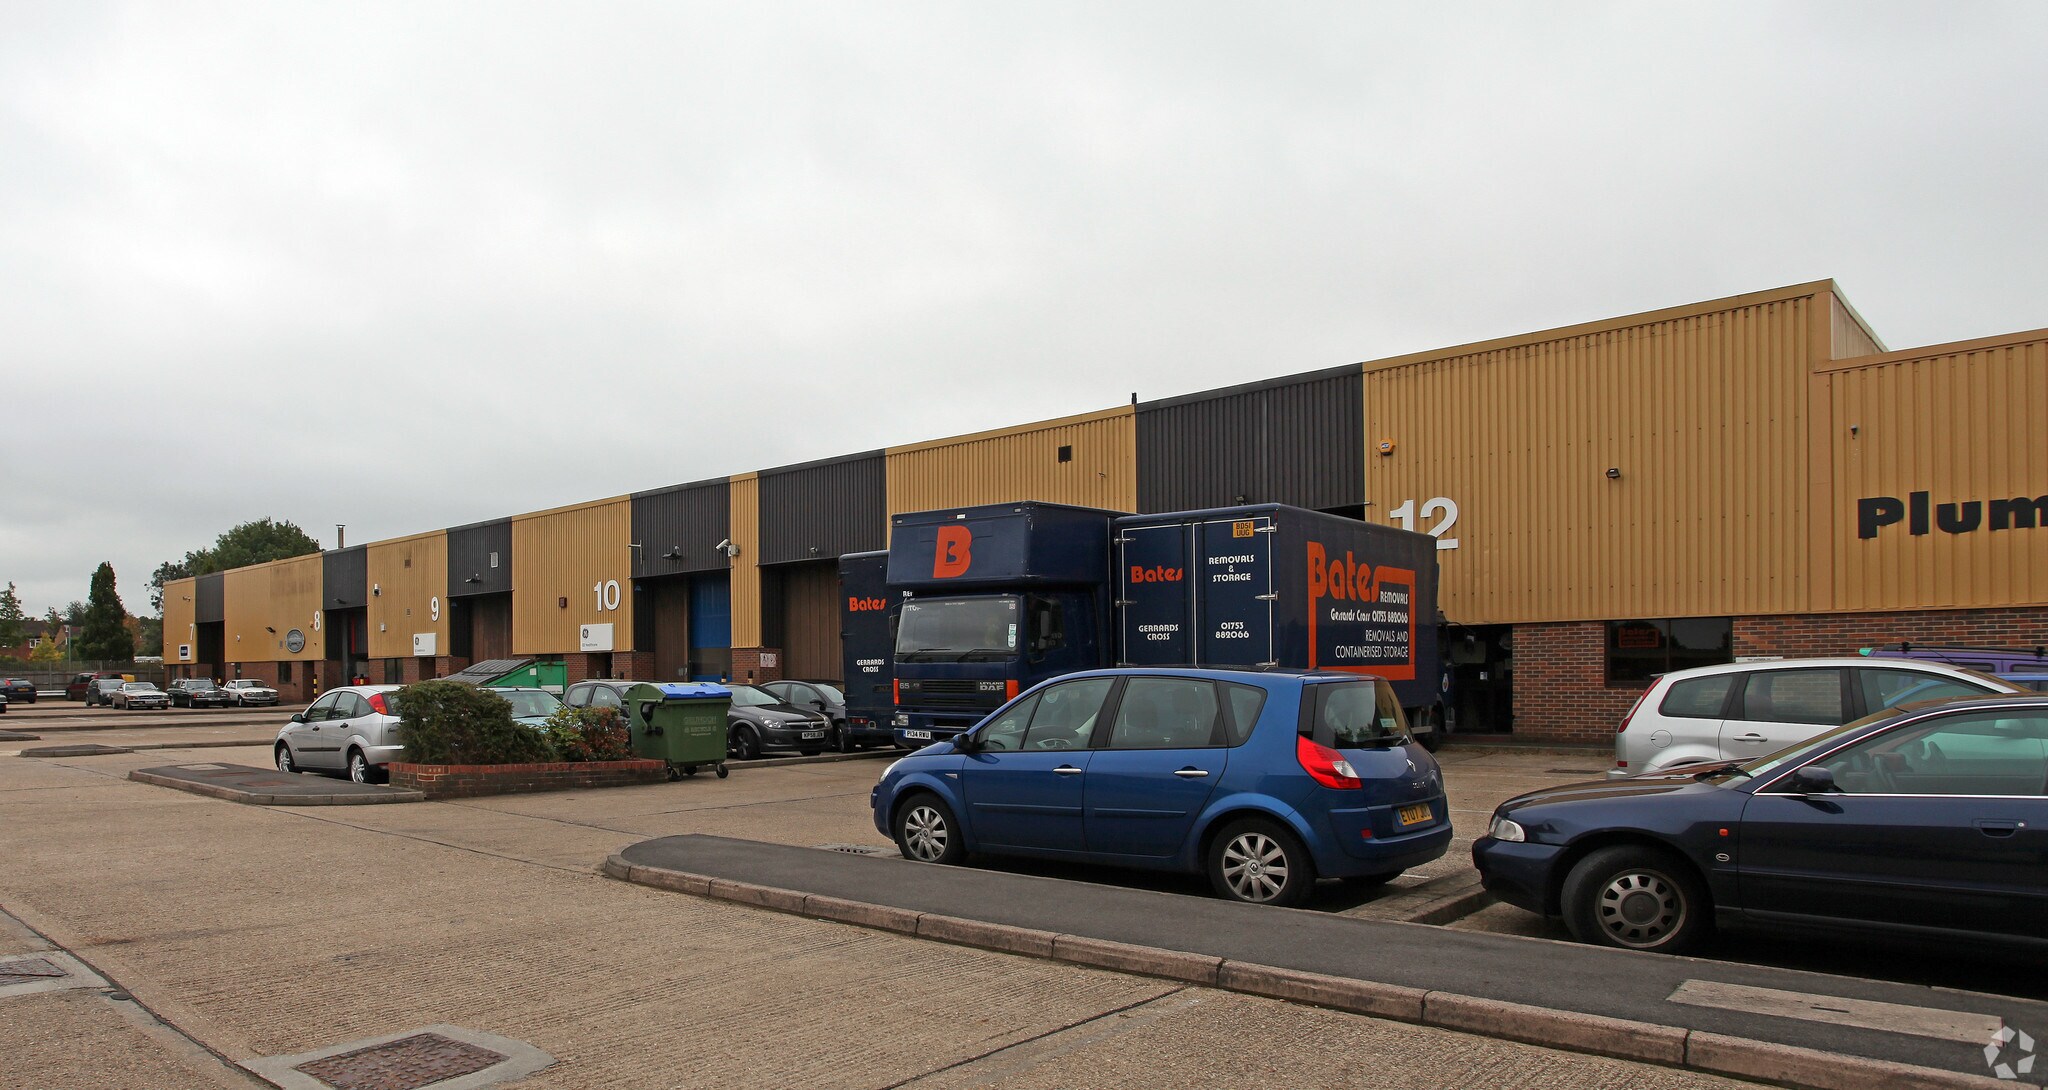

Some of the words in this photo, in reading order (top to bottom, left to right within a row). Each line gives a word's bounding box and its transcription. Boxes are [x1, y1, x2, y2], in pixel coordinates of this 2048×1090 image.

[1858, 491, 2048, 539] Plum
[1389, 497, 1458, 549] 12
[933, 525, 972, 578] B
[1208, 554, 1254, 565] REMOVALS
[1131, 565, 1183, 583] Bates
[1228, 565, 1235, 573] &
[1307, 541, 1380, 603] Bates
[1212, 573, 1252, 583] STORAGE
[593, 579, 621, 612] 10
[1380, 591, 1408, 605] REMOVALS
[430, 596, 440, 622] 9
[849, 597, 887, 612] Bates
[314, 610, 321, 632] 8
[1371, 610, 1386, 623] 01753
[1387, 611, 1409, 623] 882066
[189, 623, 195, 641] 7
[1138, 624, 1179, 632] GERRARDS
[1220, 622, 1244, 630] 01753
[1147, 633, 1170, 641] CROSS
[1215, 631, 1250, 639] 882066
[1365, 630, 1395, 641] REMOVALS
[1396, 631, 1408, 642] AND
[1335, 646, 1382, 658] CONTAINERISED
[1383, 646, 1408, 658] STORAGE
[899, 682, 910, 690] 65
